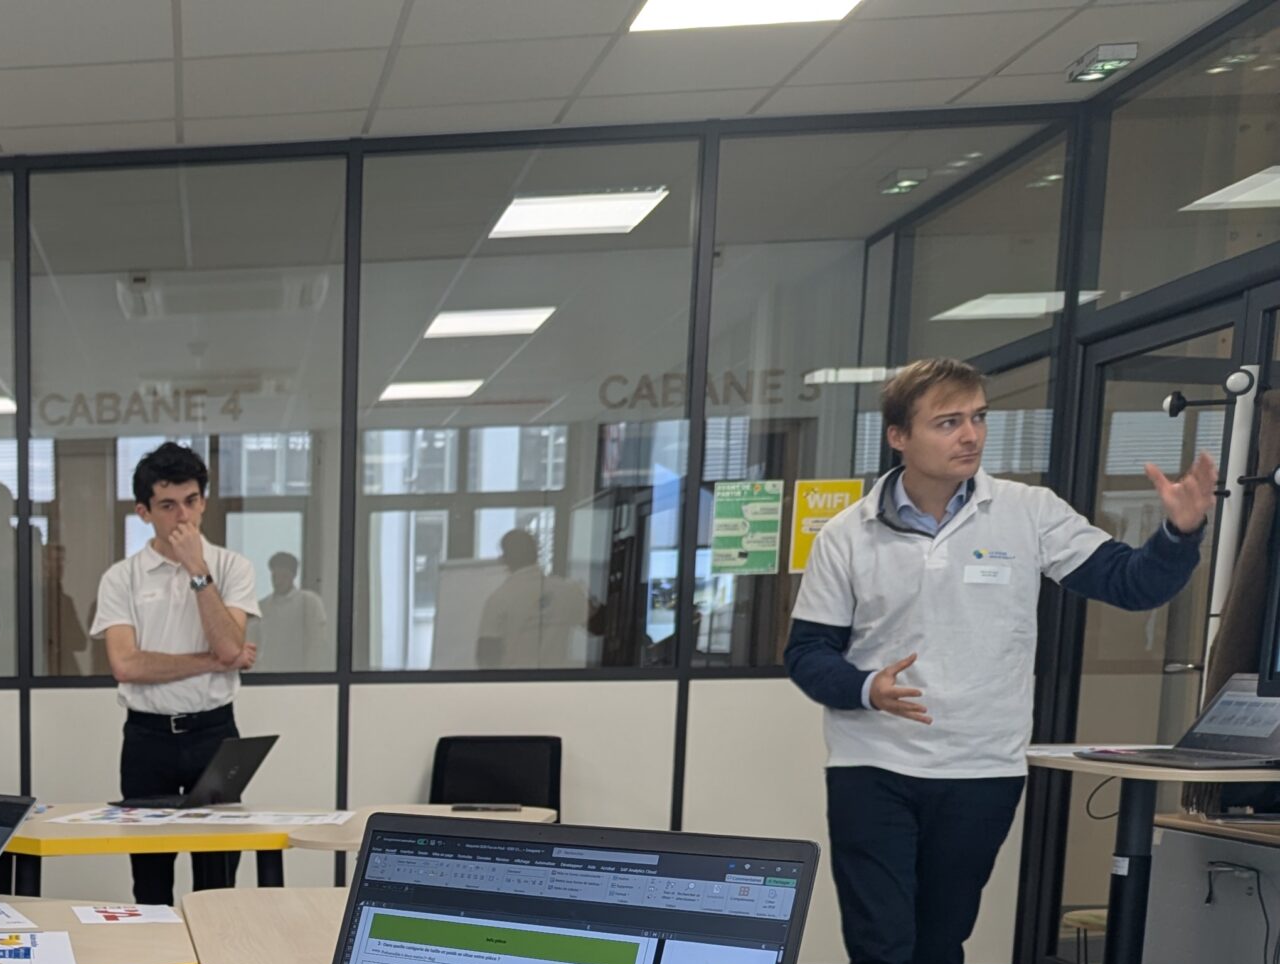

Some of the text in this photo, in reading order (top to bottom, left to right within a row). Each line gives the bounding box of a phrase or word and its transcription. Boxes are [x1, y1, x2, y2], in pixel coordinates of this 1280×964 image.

[38, 388, 243, 426] CABANE 4
[807, 492, 850, 509] WIFI
